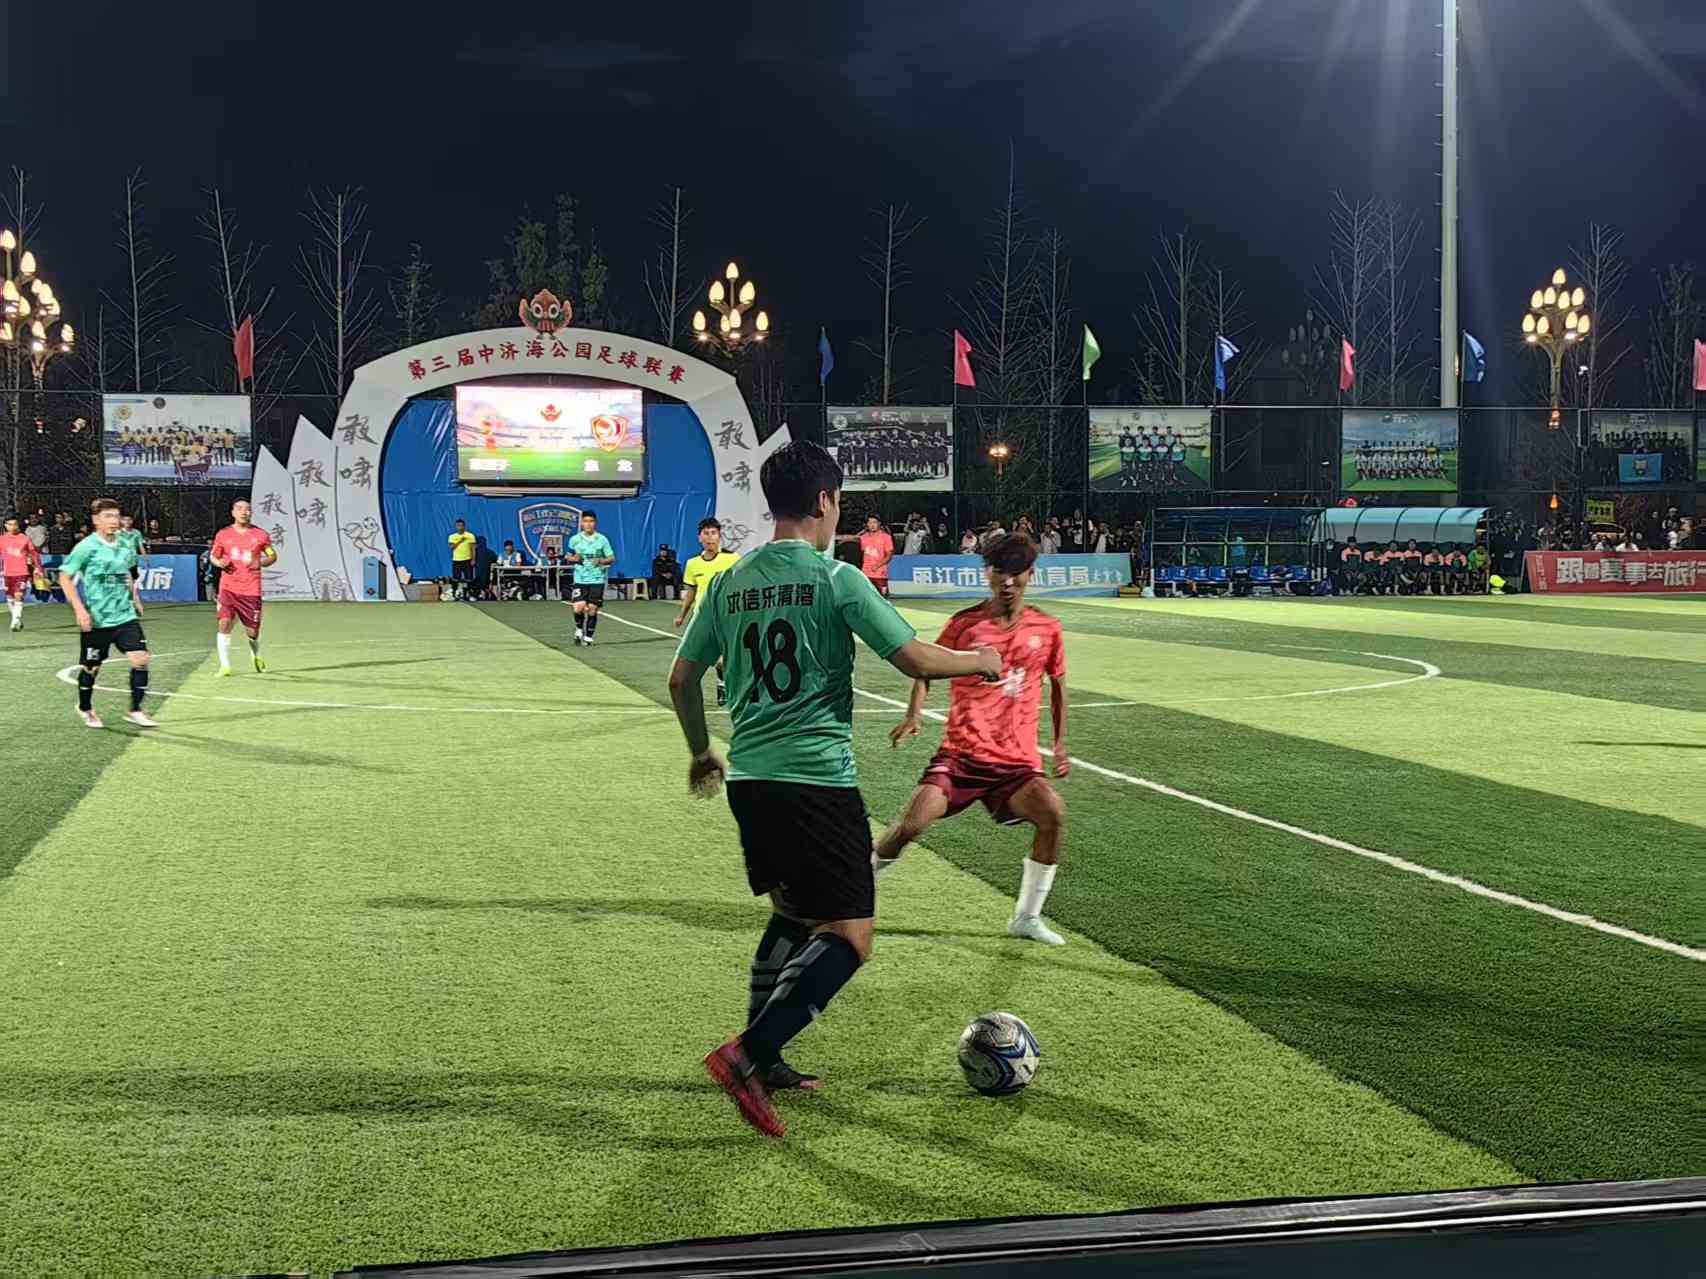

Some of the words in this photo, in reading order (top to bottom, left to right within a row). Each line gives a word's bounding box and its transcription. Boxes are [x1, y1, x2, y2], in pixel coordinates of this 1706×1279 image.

[408, 340, 686, 384] 第三届中济海公园足球联赛
[743, 618, 801, 704] 18
